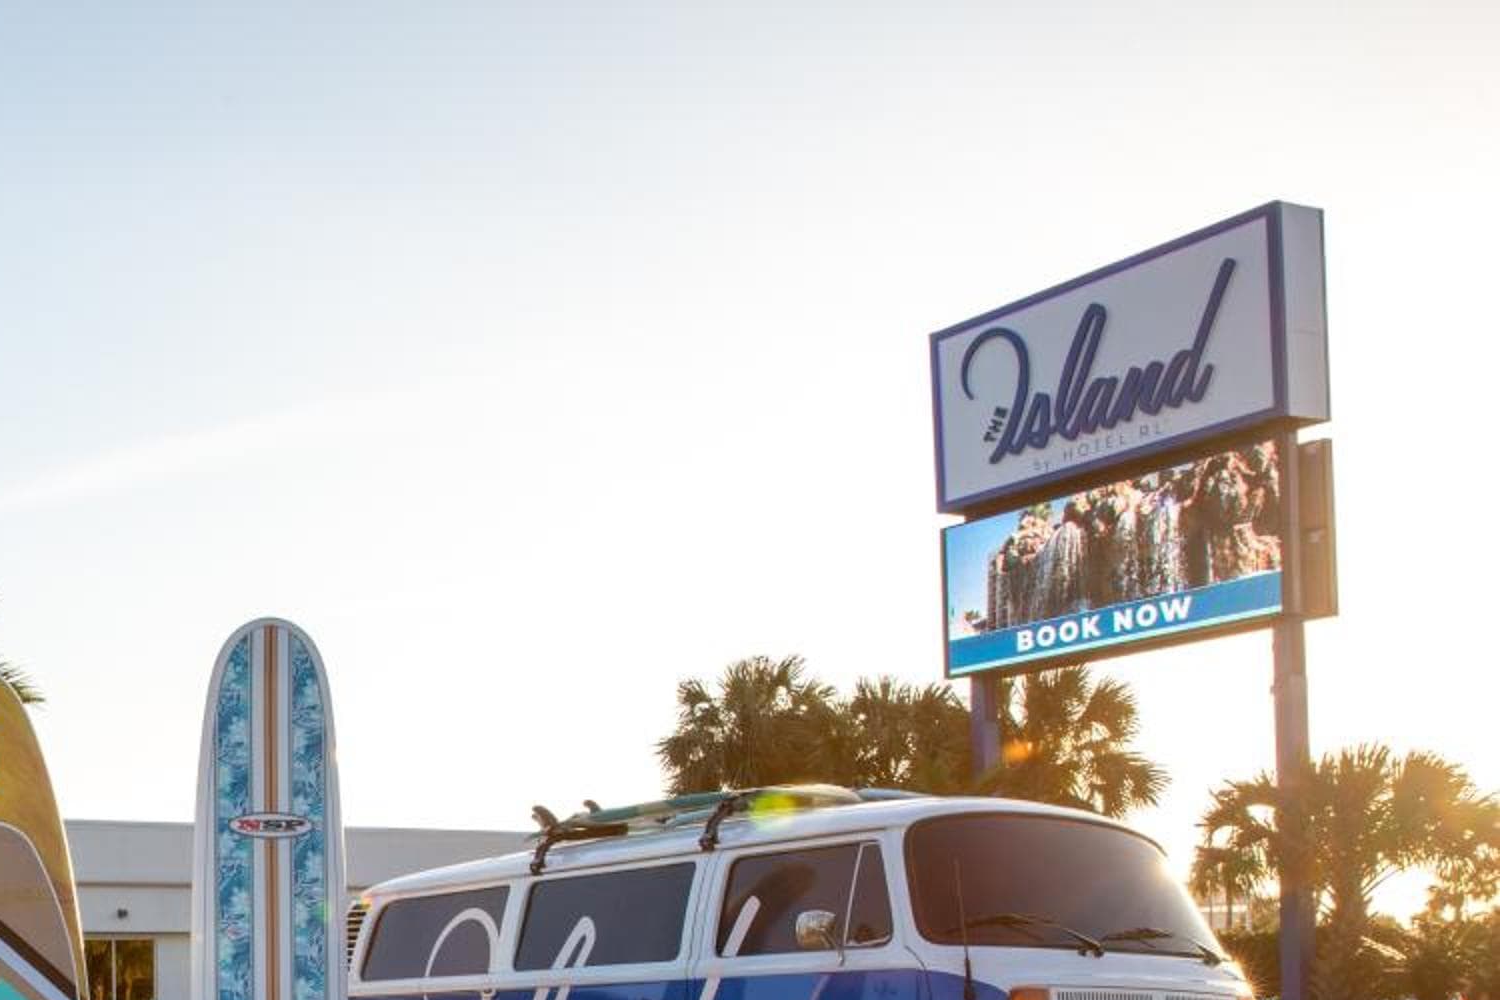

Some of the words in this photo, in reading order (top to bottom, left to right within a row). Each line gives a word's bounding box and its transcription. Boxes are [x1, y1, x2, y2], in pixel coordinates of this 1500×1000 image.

[961, 258, 1236, 464] Island
[984, 407, 1008, 442] THE
[1016, 614, 1101, 653] BOOK
[1112, 596, 1192, 633] NOW
